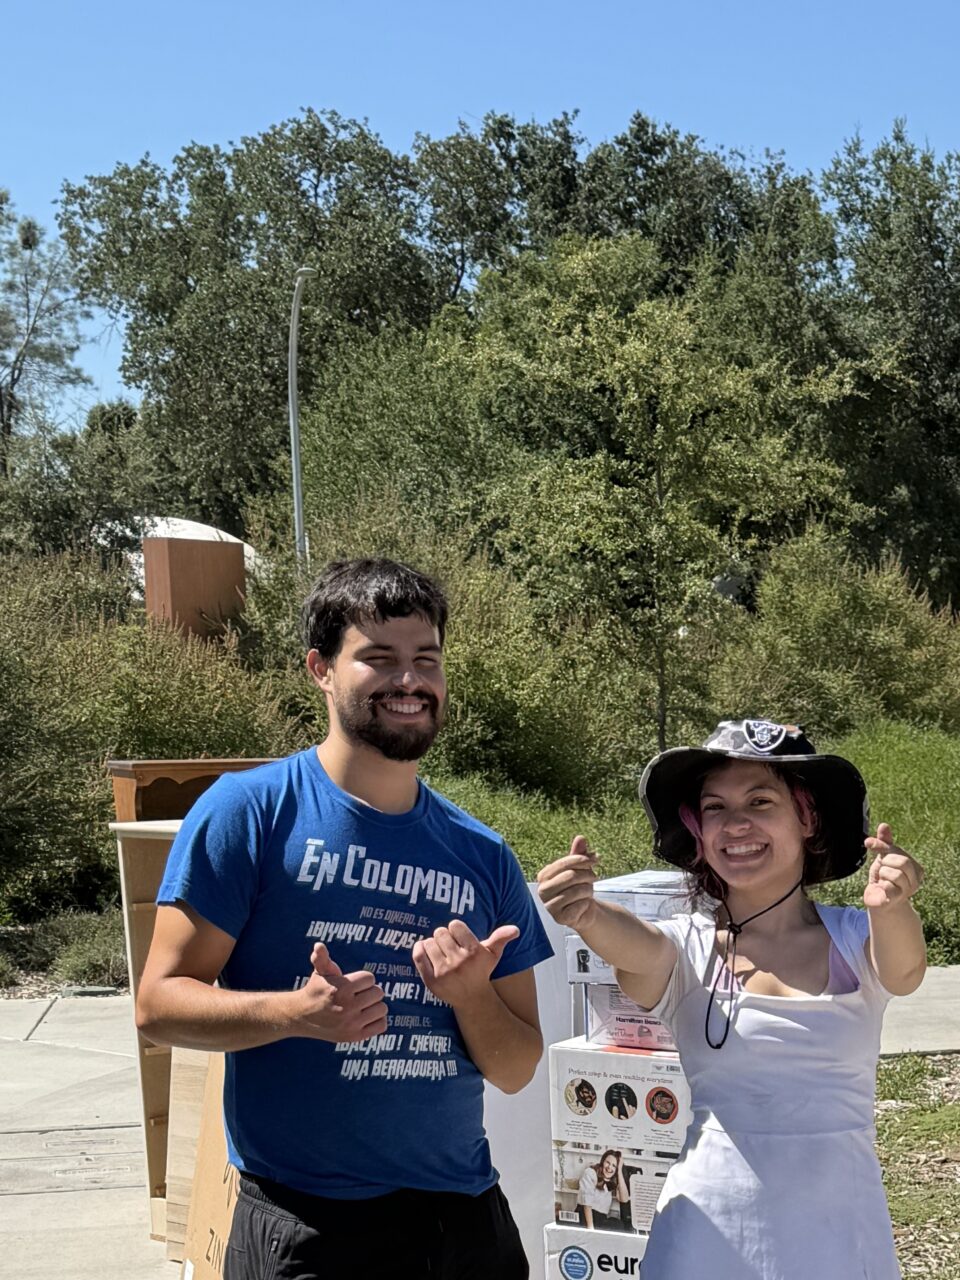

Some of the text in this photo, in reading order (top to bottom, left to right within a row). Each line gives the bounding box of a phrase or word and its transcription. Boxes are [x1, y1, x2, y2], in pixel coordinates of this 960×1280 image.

[340, 1059, 370, 1080] UNA
[205, 1227, 225, 1274] ZIN
[597, 1253, 642, 1275] eur
